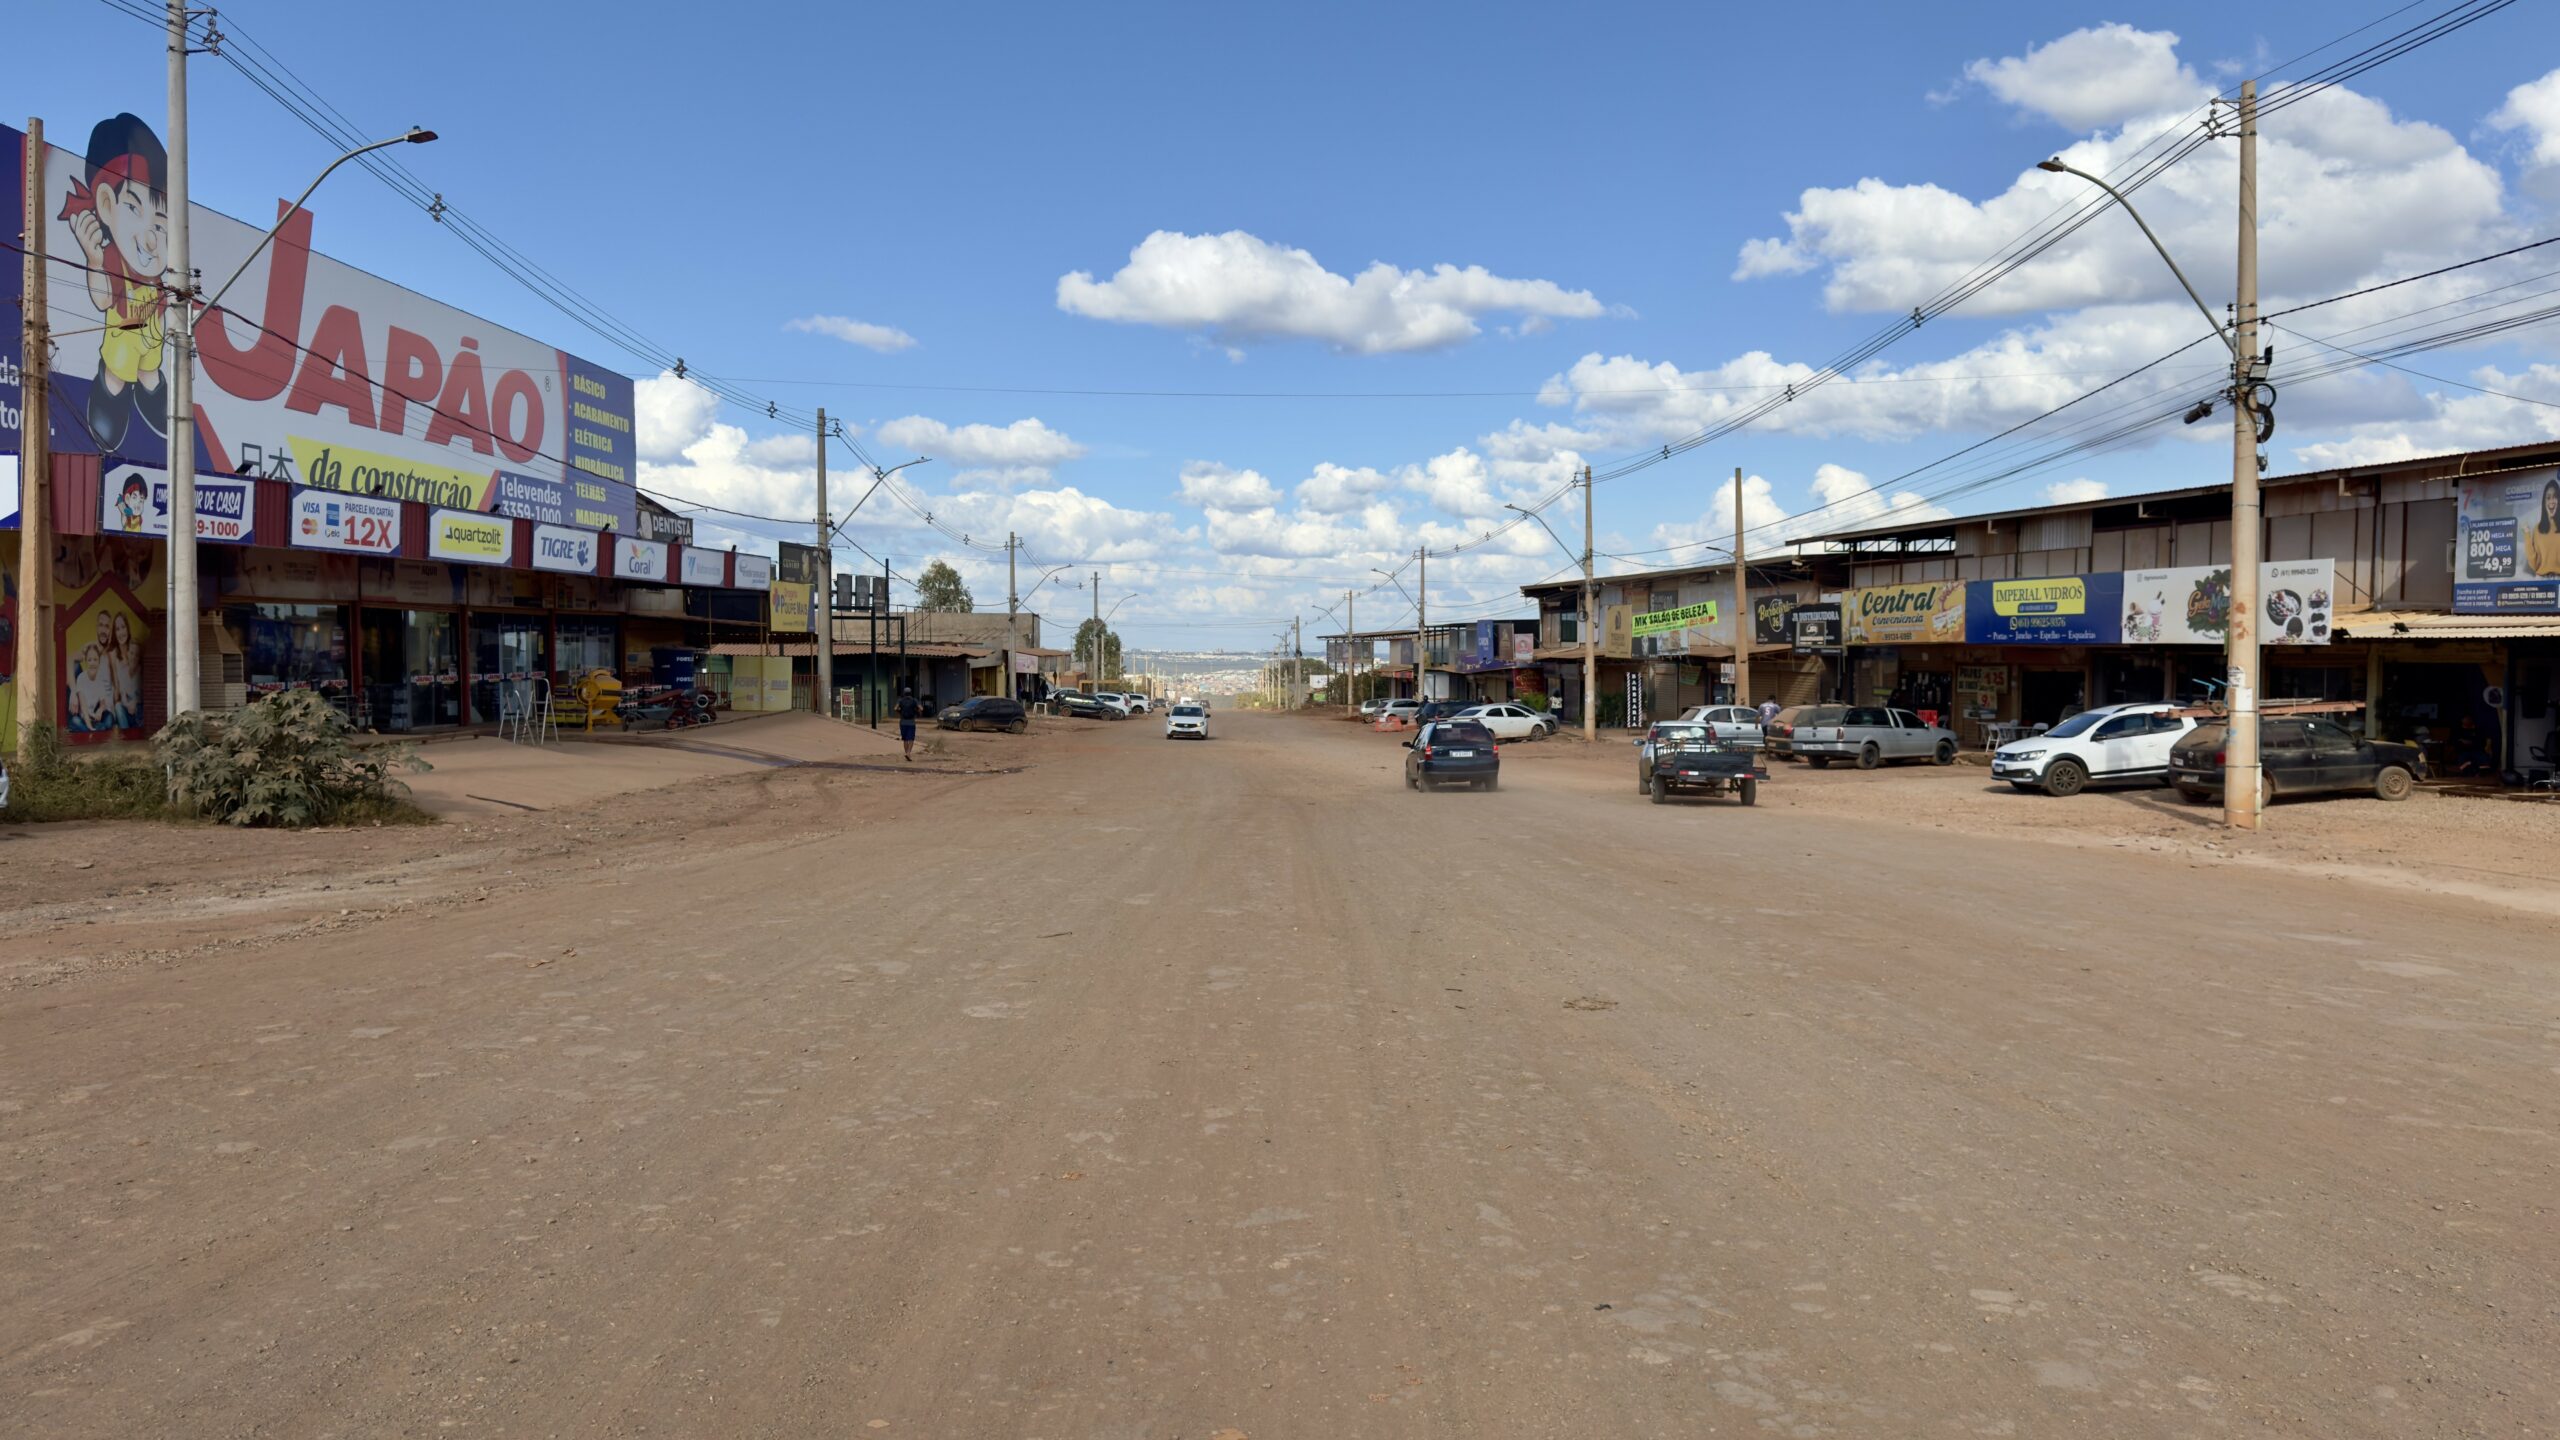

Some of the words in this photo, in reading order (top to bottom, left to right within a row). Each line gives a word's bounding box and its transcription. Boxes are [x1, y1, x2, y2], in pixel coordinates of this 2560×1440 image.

[194, 198, 545, 464] JAPÃO
[573, 374, 606, 400] BÁSICO
[574, 401, 630, 433] ACABAMENTO
[574, 428, 613, 454] ELÉTRICA
[309, 448, 342, 490] da
[575, 455, 625, 482] HIDRÁULICA
[203, 490, 215, 512] DE
[216, 491, 242, 516] CASA
[501, 476, 562, 507] Televendas
[575, 482, 607, 503] TELHAS
[303, 500, 320, 514] VISA
[345, 502, 368, 515] PARCELE
[376, 506, 394, 518] CARTÃO
[502, 499, 562, 526] 3359-1000
[575, 508, 619, 531] MADEIRAS
[343, 515, 392, 549] 12X
[453, 526, 502, 546] quartzolit
[652, 516, 692, 537] DENTISTA
[2471, 529, 2491, 543] 200
[540, 536, 575, 560] TIGRE
[2470, 541, 2494, 558] 800
[2495, 544, 2512, 552] MEGA
[629, 556, 651, 575] Coral
[1862, 586, 1937, 617] Central
[1996, 588, 2042, 603] IMPERIAL
[2044, 585, 2083, 601] VIDROS
[1634, 615, 1648, 628] MK
[1680, 603, 1709, 620] BELEZA
